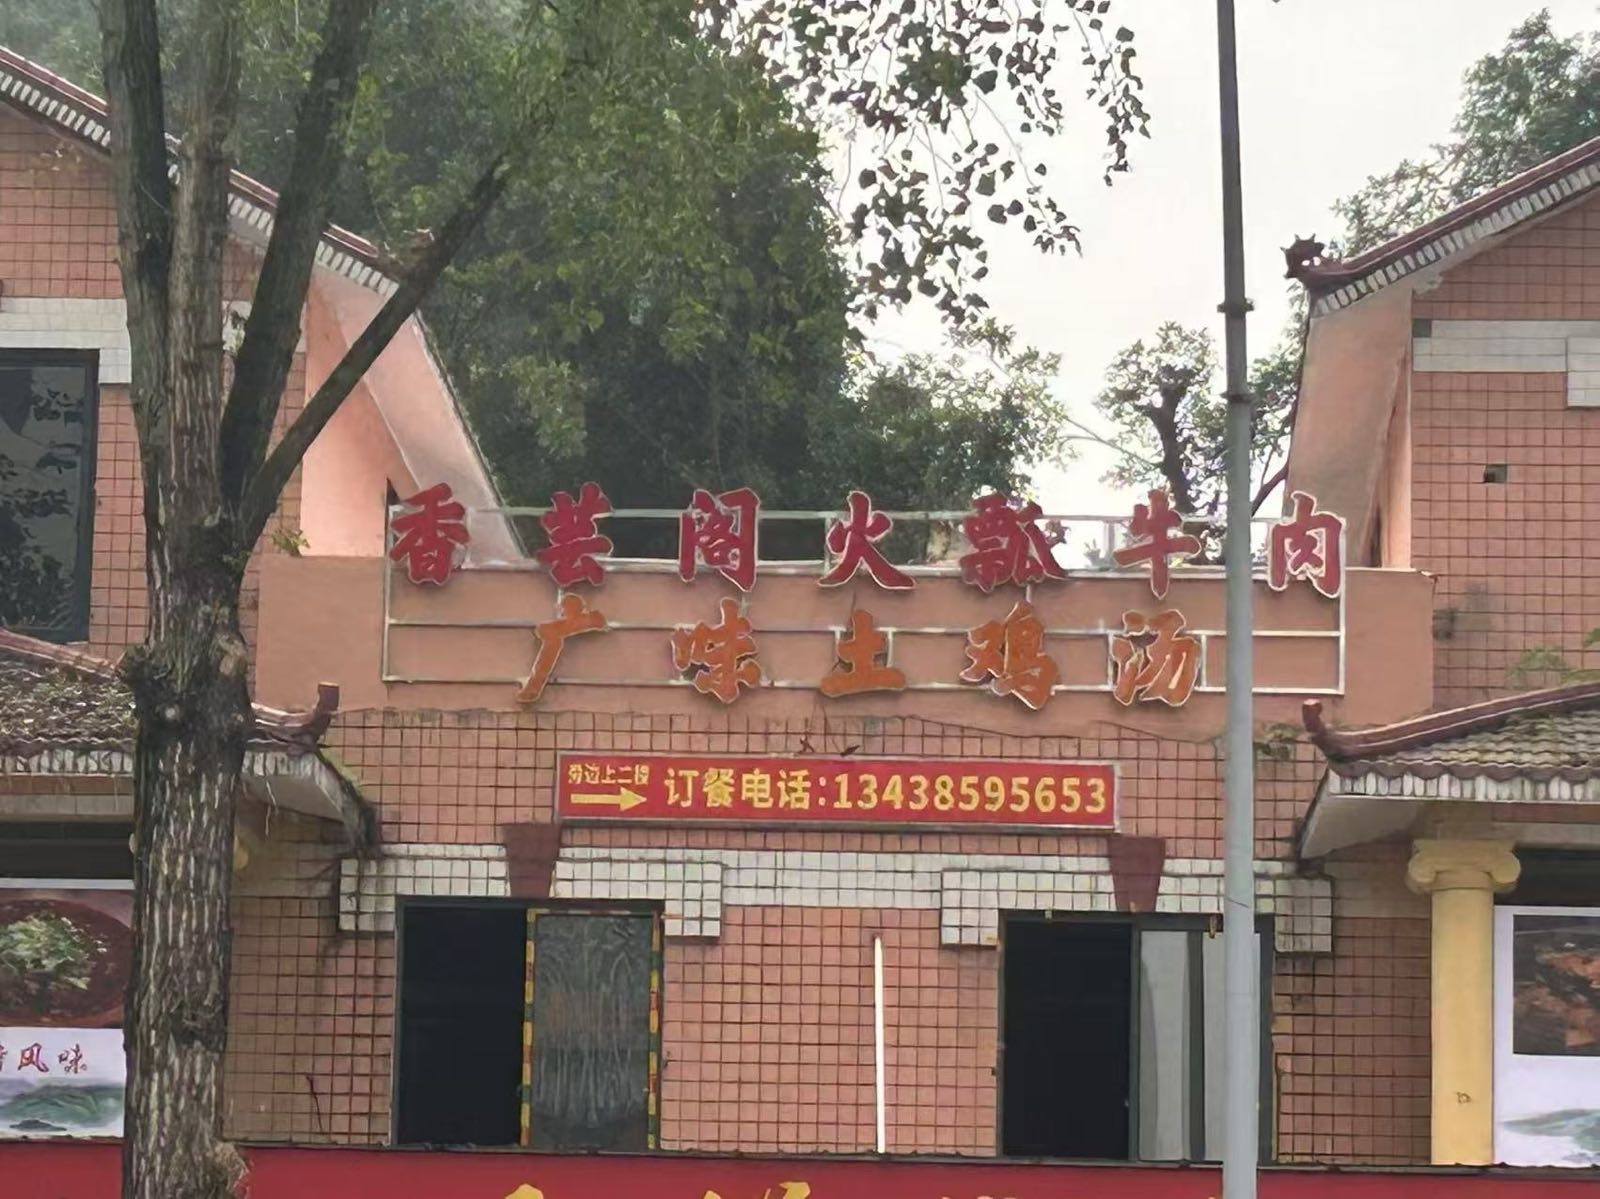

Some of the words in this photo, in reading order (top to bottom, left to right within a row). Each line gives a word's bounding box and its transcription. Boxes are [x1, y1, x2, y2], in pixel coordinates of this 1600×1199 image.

[389, 482, 1346, 598] 香芸阁火瓢牛肉
[516, 593, 1199, 710] 广味土鸡汤
[664, 767, 1106, 814] 订餐电话:13438595653
